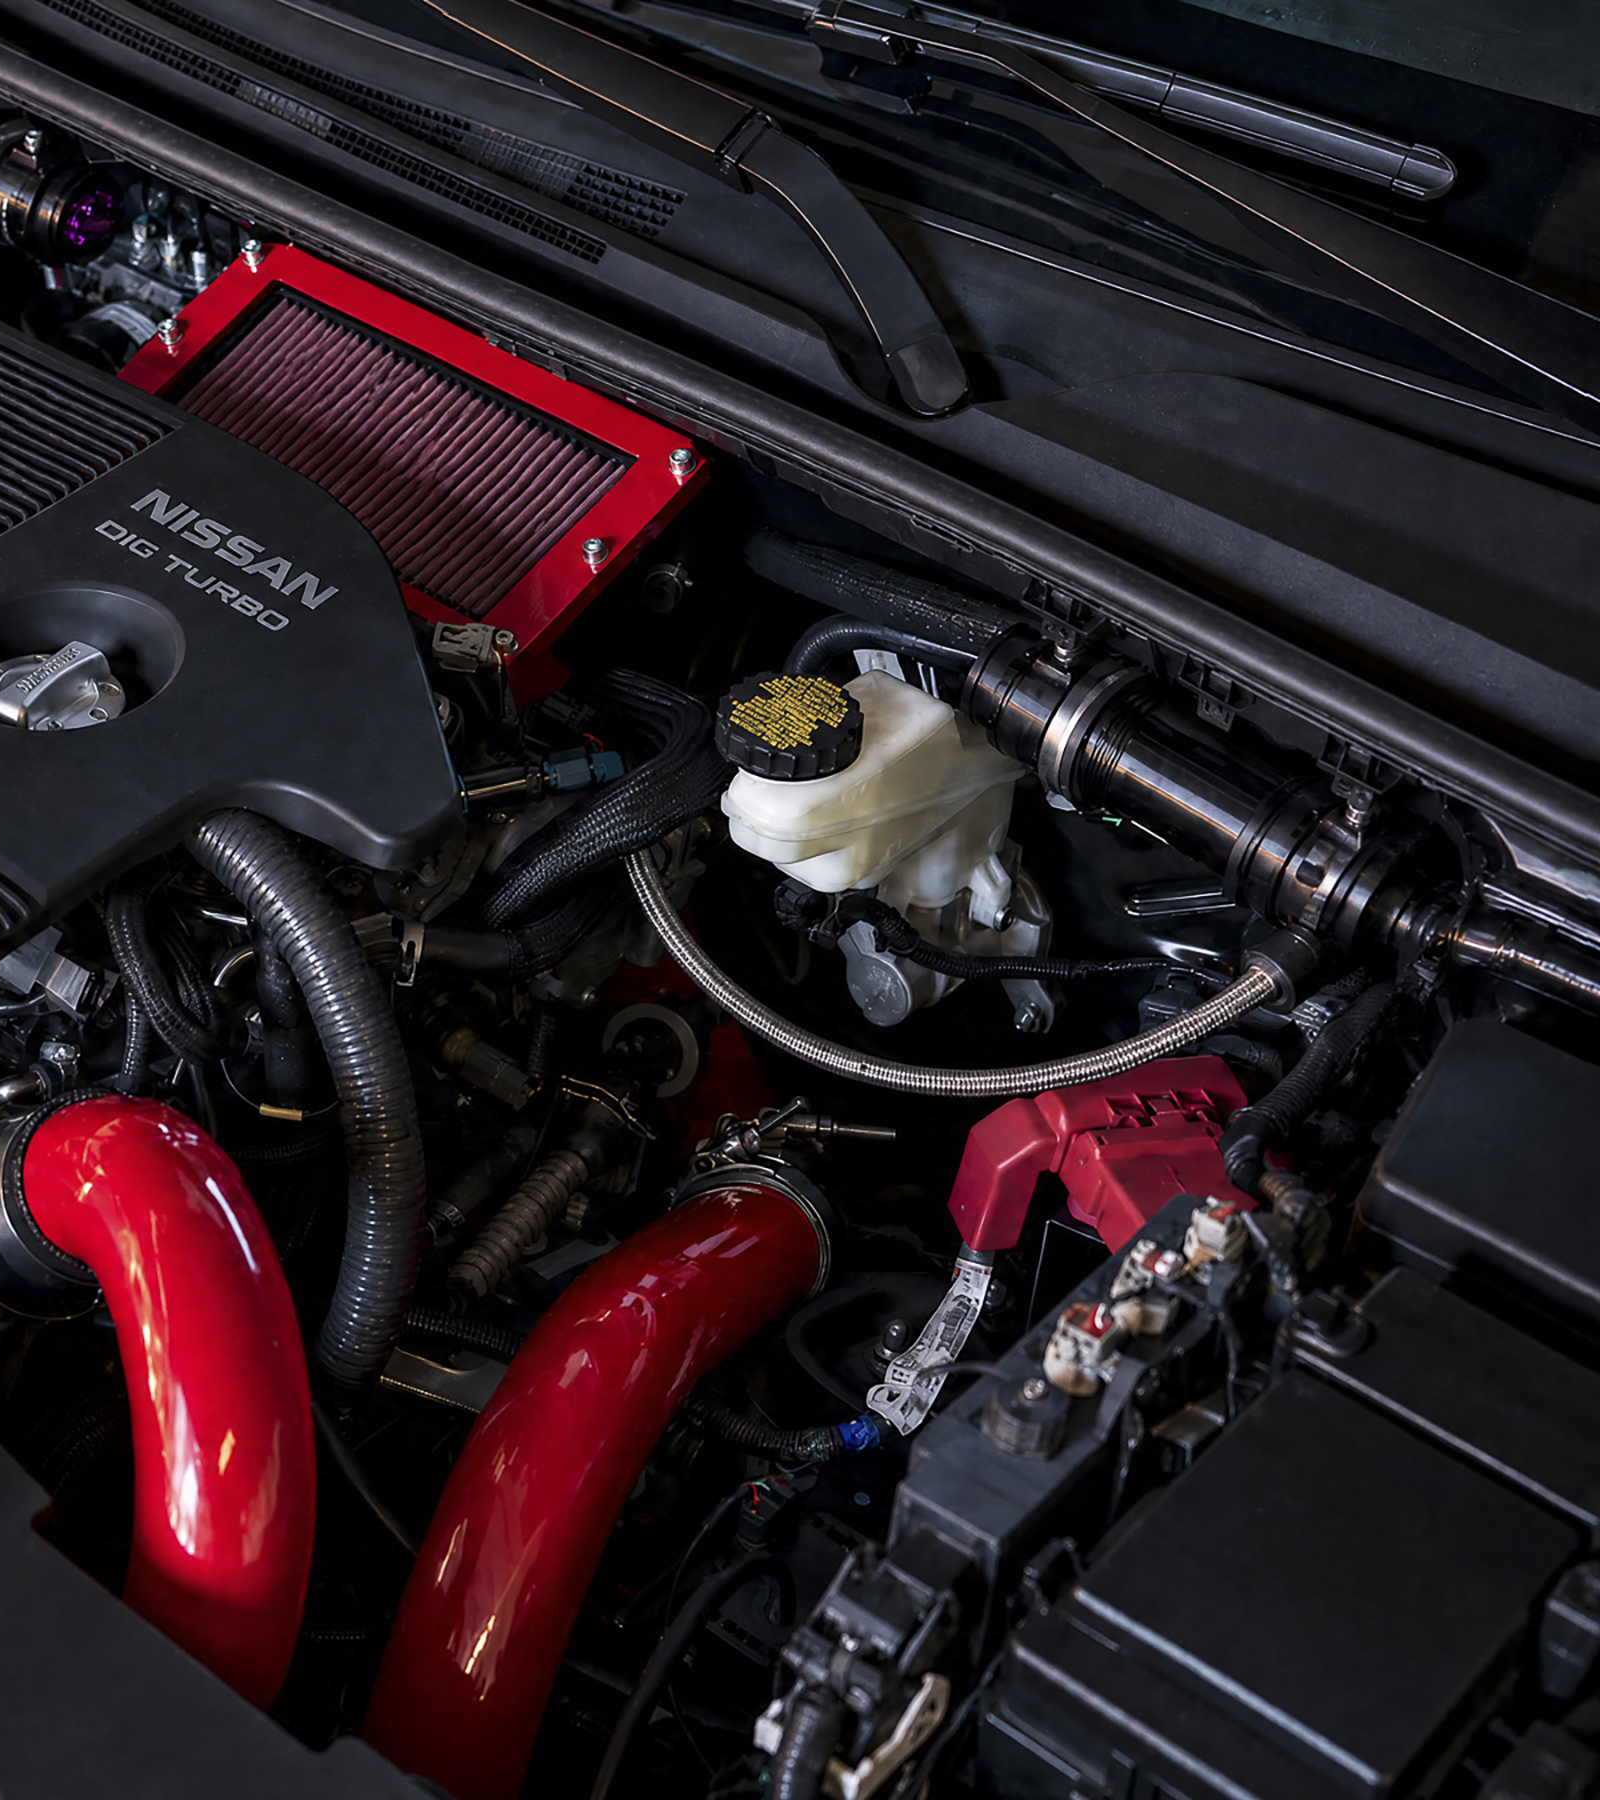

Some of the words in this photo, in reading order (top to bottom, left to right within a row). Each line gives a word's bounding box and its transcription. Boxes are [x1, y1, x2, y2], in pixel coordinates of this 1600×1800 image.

[94, 519, 159, 558] DIG
[164, 554, 290, 632] TURBO
[130, 488, 339, 610] NISSAN
